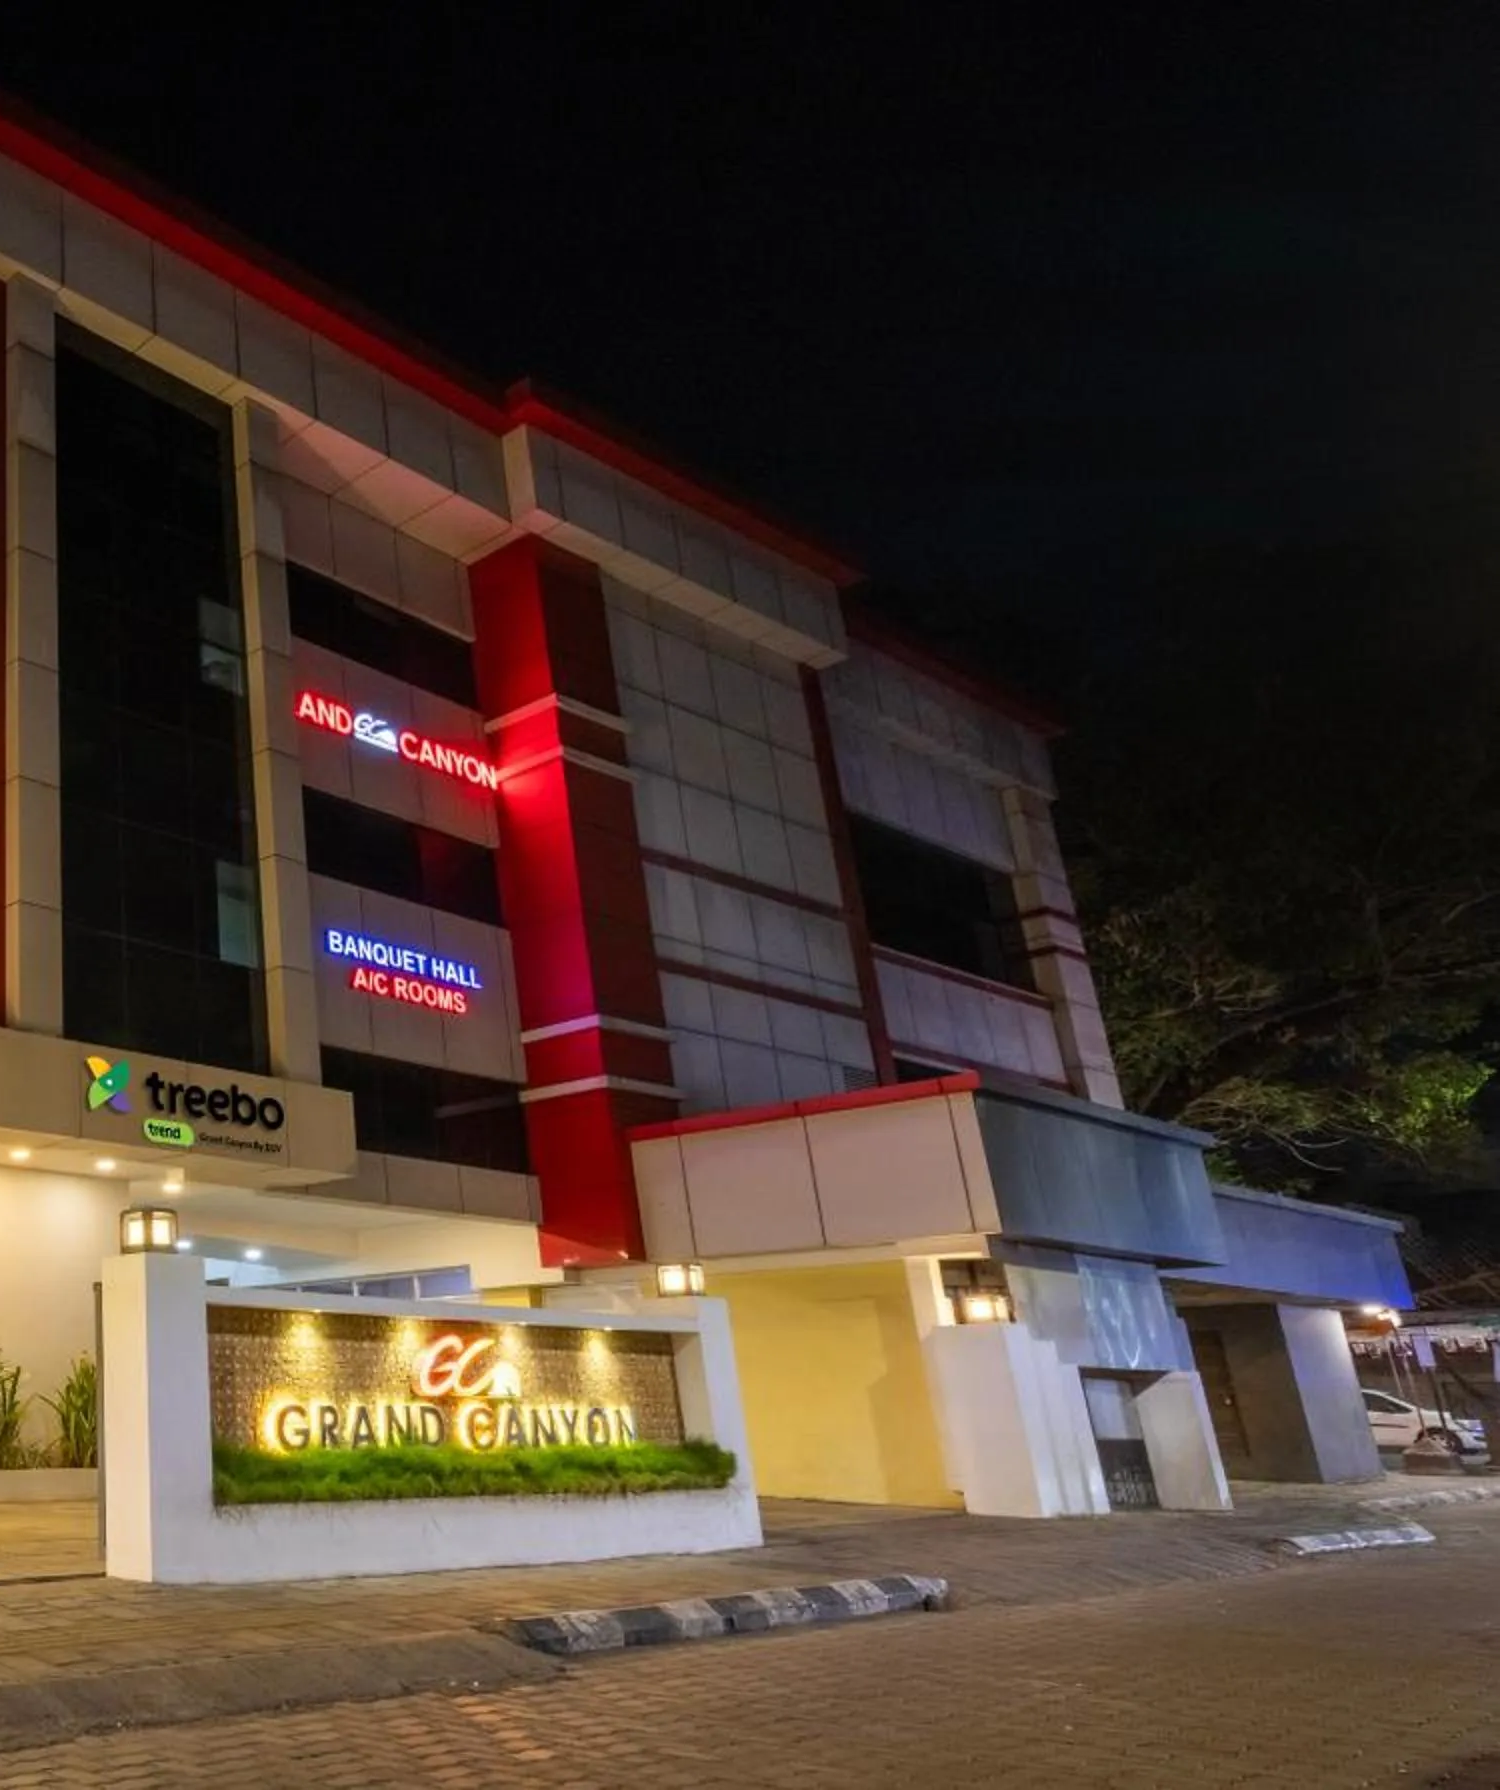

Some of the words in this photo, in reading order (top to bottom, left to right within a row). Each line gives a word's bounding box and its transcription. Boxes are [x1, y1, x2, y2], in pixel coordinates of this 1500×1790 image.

[298, 692, 352, 734] AND
[400, 731, 498, 791] CANYON
[327, 930, 427, 975] BANQUET
[431, 957, 484, 989] HALL
[394, 977, 467, 1013] ROOMS
[145, 1071, 285, 1130] treebo
[148, 1123, 181, 1140] trend
[277, 1404, 446, 1451] GRAND
[467, 1406, 638, 1450] CANYON
